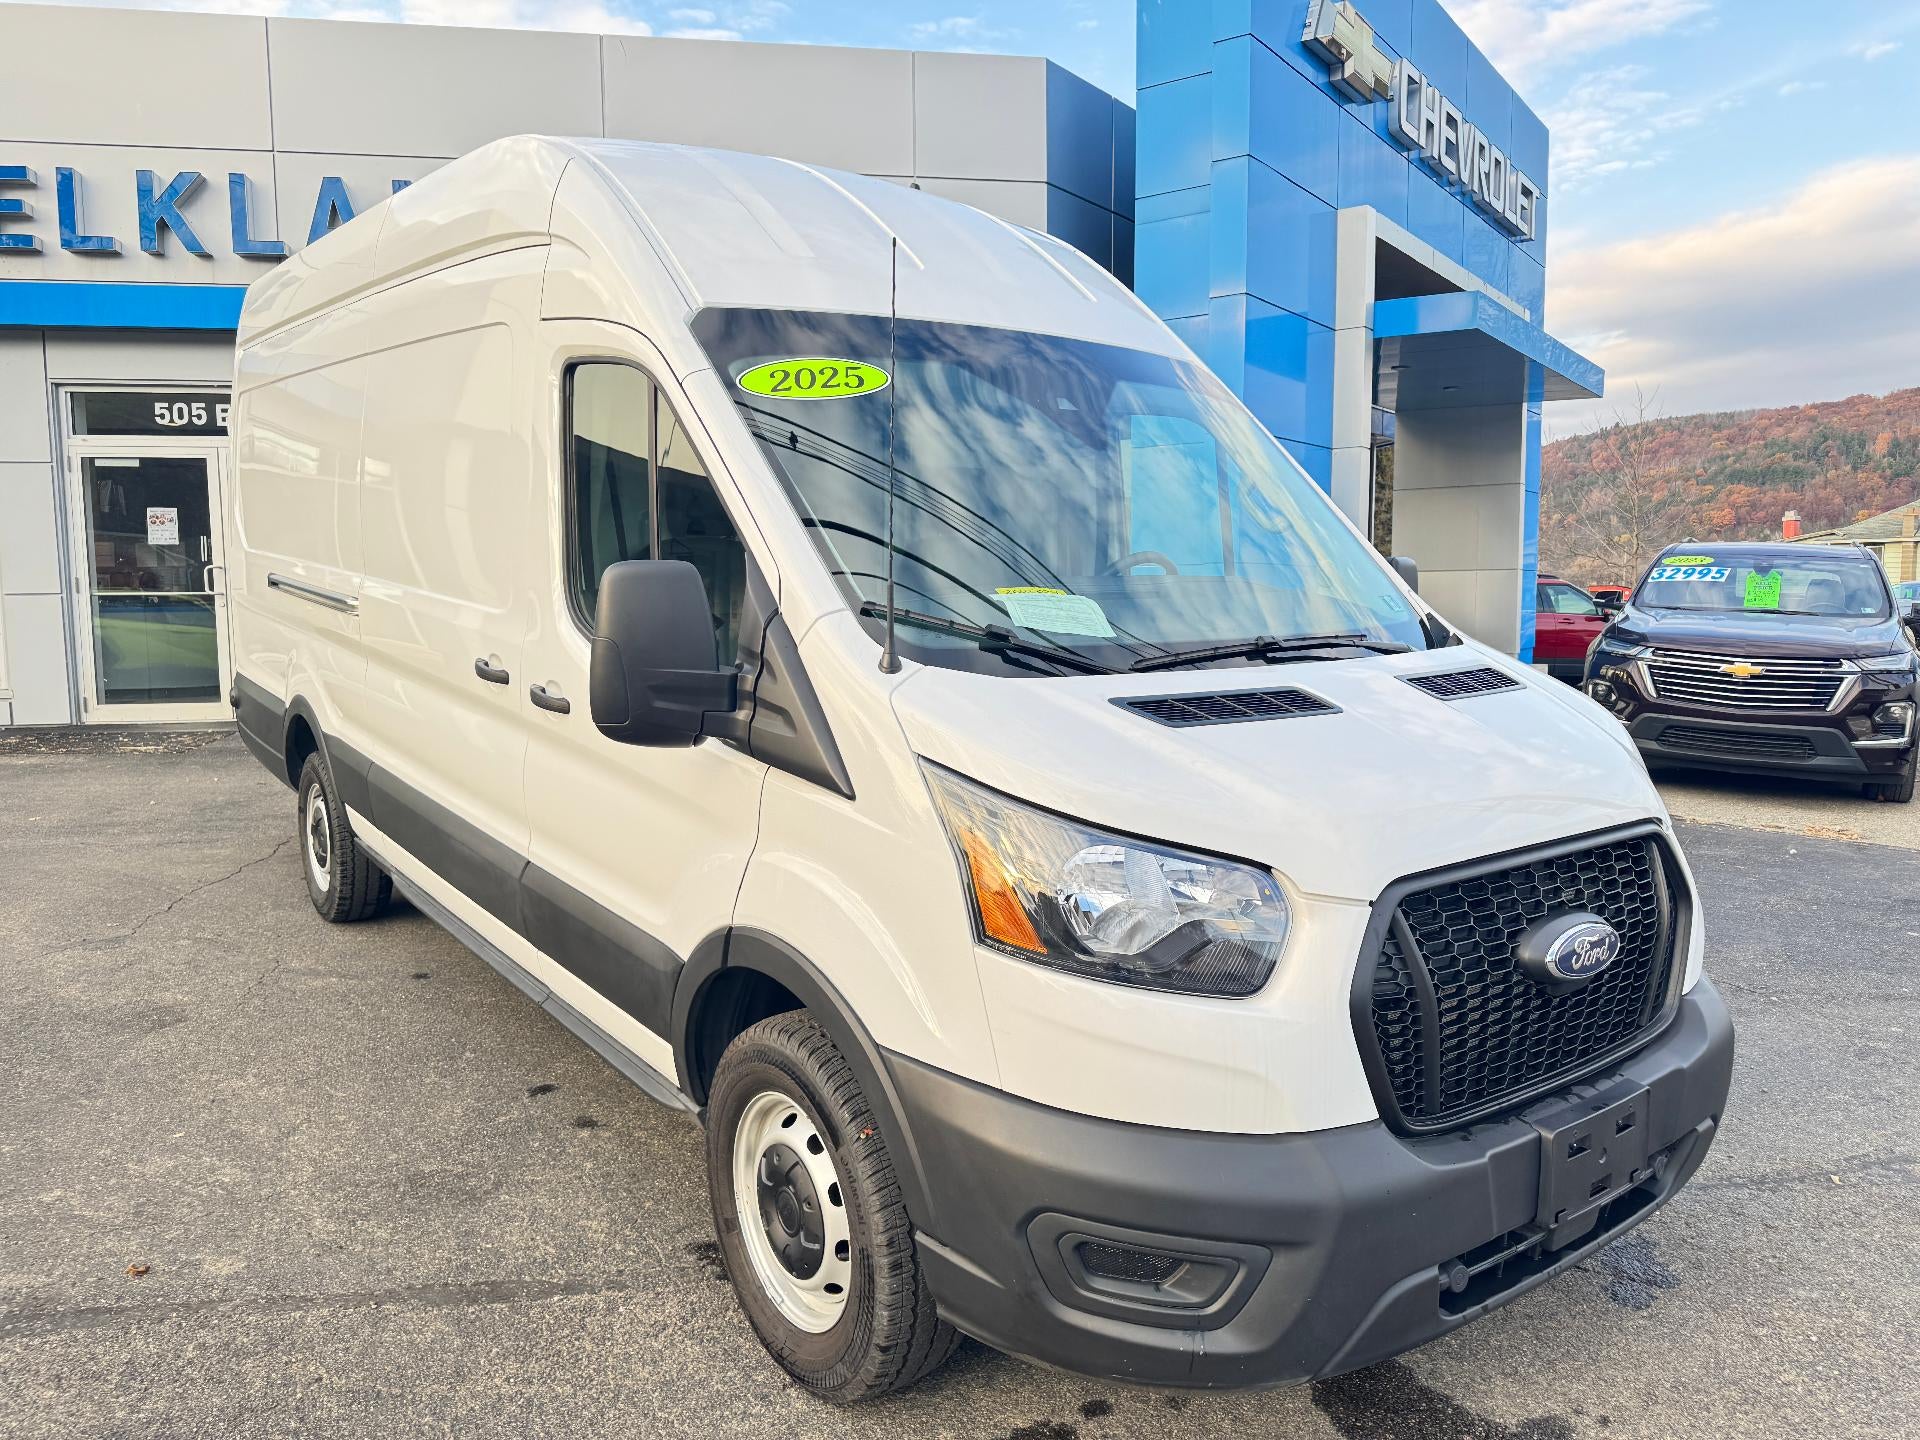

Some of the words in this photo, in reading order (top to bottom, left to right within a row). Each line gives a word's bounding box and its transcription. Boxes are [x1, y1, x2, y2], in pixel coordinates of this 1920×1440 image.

[1390, 58, 1541, 241] CHEVROLET
[0, 165, 413, 257] ELKLA
[769, 366, 865, 393] 2025
[154, 402, 207, 426] 505
[1651, 568, 1728, 580] 32995
[1572, 933, 1610, 970] Ford
